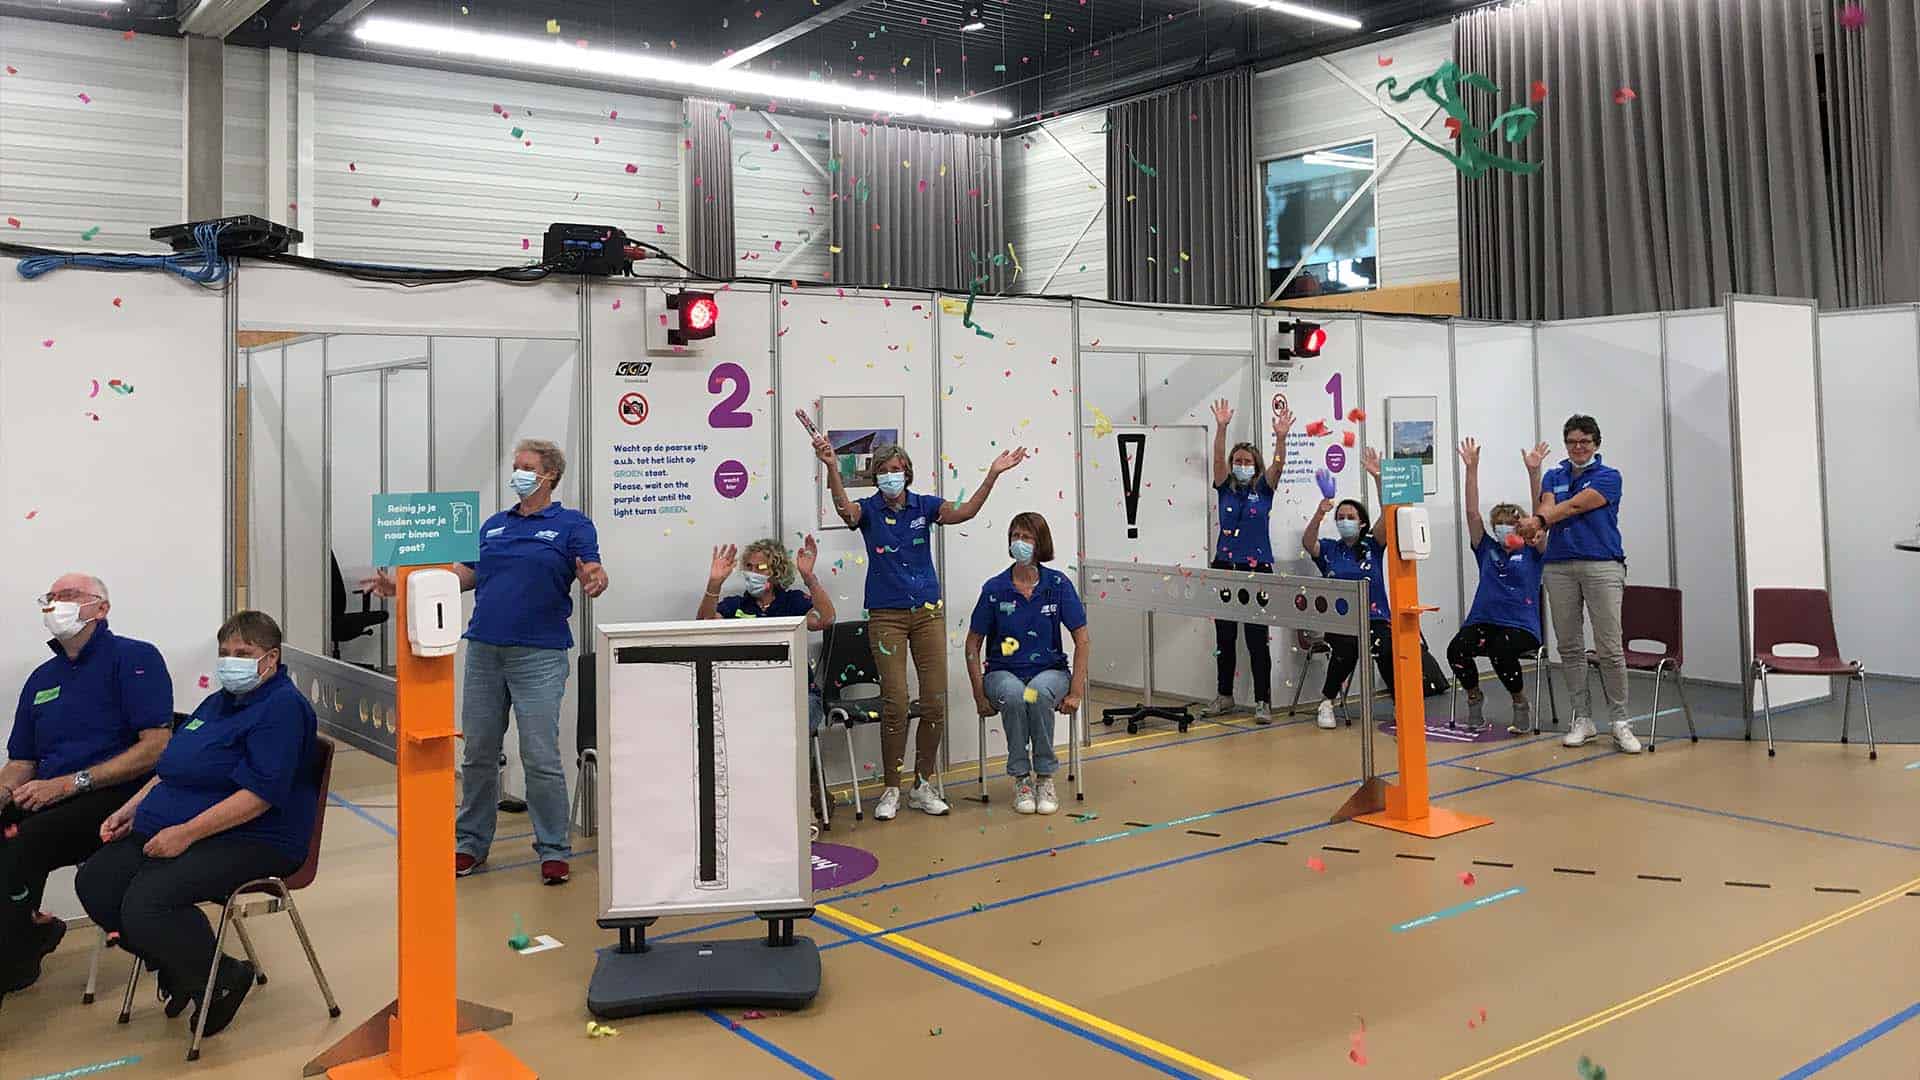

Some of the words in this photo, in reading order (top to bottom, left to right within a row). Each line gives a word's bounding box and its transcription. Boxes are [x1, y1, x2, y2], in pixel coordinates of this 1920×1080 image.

[616, 362, 651, 376] GGD
[708, 362, 753, 428] 2
[1325, 372, 1343, 420] 1
[613, 445, 640, 453] Wacht
[642, 445, 651, 454] op
[654, 444, 664, 452] de
[666, 445, 692, 453] paarse
[694, 444, 708, 452] stip
[666, 456, 684, 464] licht
[645, 482, 662, 490] wait
[675, 481, 689, 489] the
[613, 496, 641, 505] purple
[658, 493, 676, 501] until
[678, 493, 691, 501] the
[388, 504, 416, 514] Reinig
[417, 504, 426, 514] je
[428, 504, 436, 513] je
[613, 508, 633, 518] light
[635, 507, 656, 516] turns
[377, 518, 412, 526] handen
[437, 516, 446, 526] je
[384, 532, 406, 540] naar
[409, 530, 439, 538] binnen
[399, 544, 425, 554] gaat?
[614, 641, 792, 889] T
